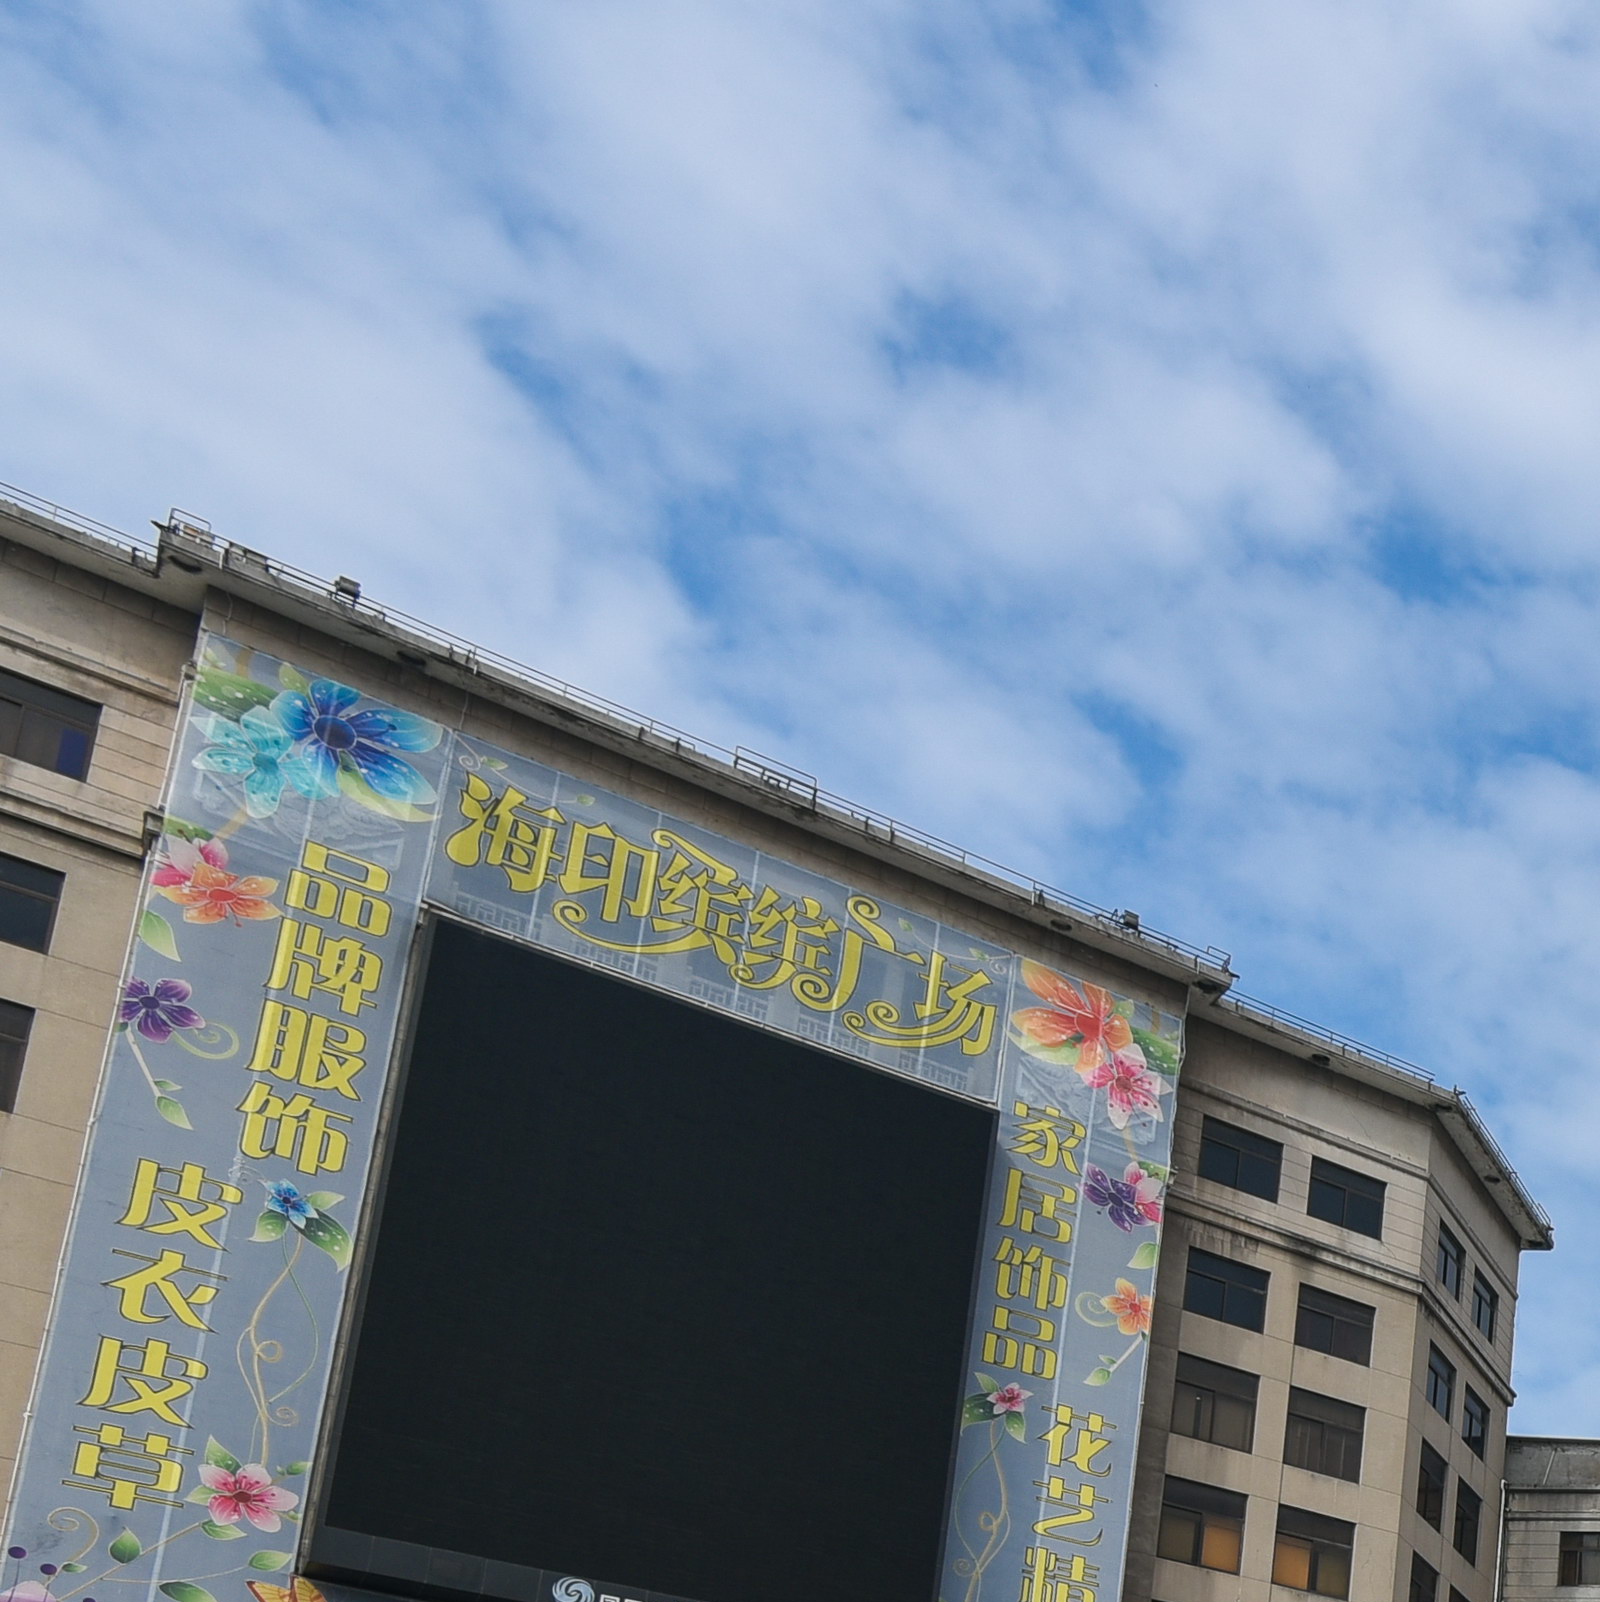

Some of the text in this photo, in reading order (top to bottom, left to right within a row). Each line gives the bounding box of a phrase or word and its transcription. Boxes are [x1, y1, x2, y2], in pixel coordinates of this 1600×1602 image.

[236, 841, 392, 1176] 品牌服饰
[443, 772, 997, 1057] 海印缤缤广场
[64, 1158, 243, 1511] 皮衣皮草
[980, 1099, 1087, 1380] 家居饰品
